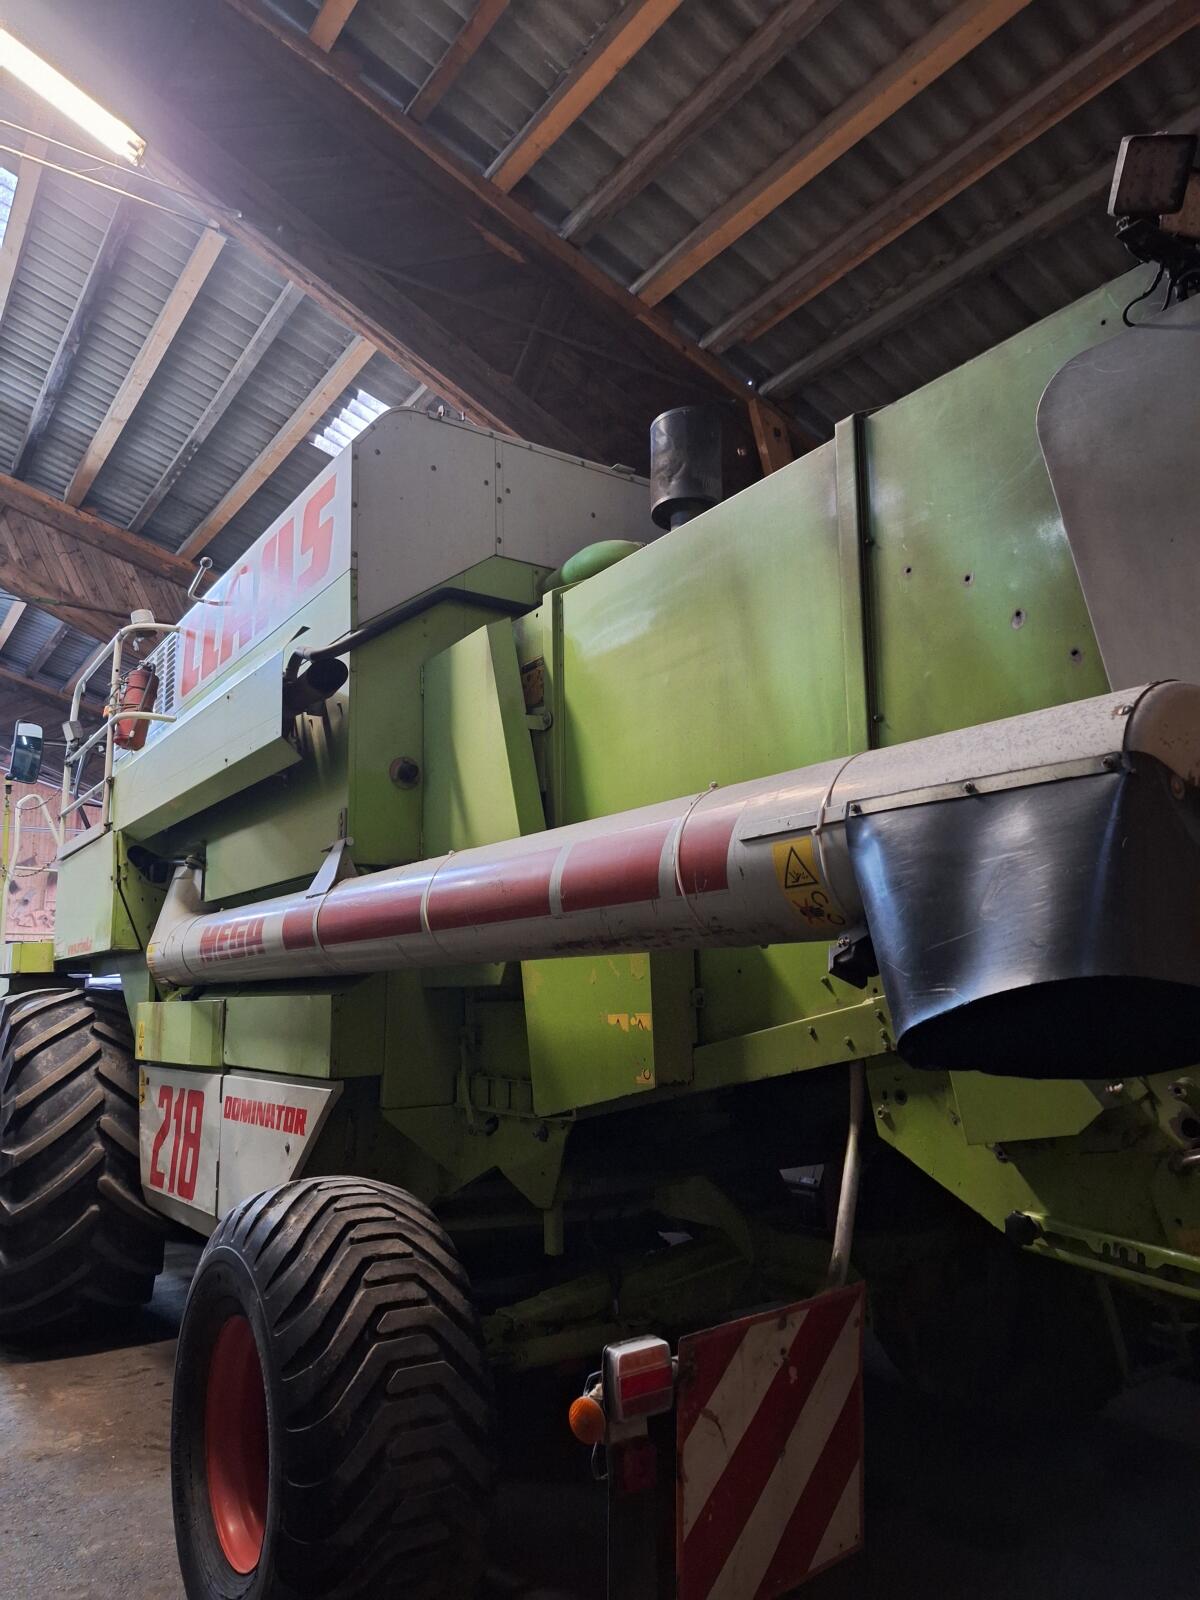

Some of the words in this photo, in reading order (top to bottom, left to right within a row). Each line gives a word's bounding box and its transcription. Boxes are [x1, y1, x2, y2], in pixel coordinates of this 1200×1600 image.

[199, 917, 266, 962] MEGA
[223, 1095, 308, 1137] DOMINATOR
[150, 1085, 205, 1201] 218
